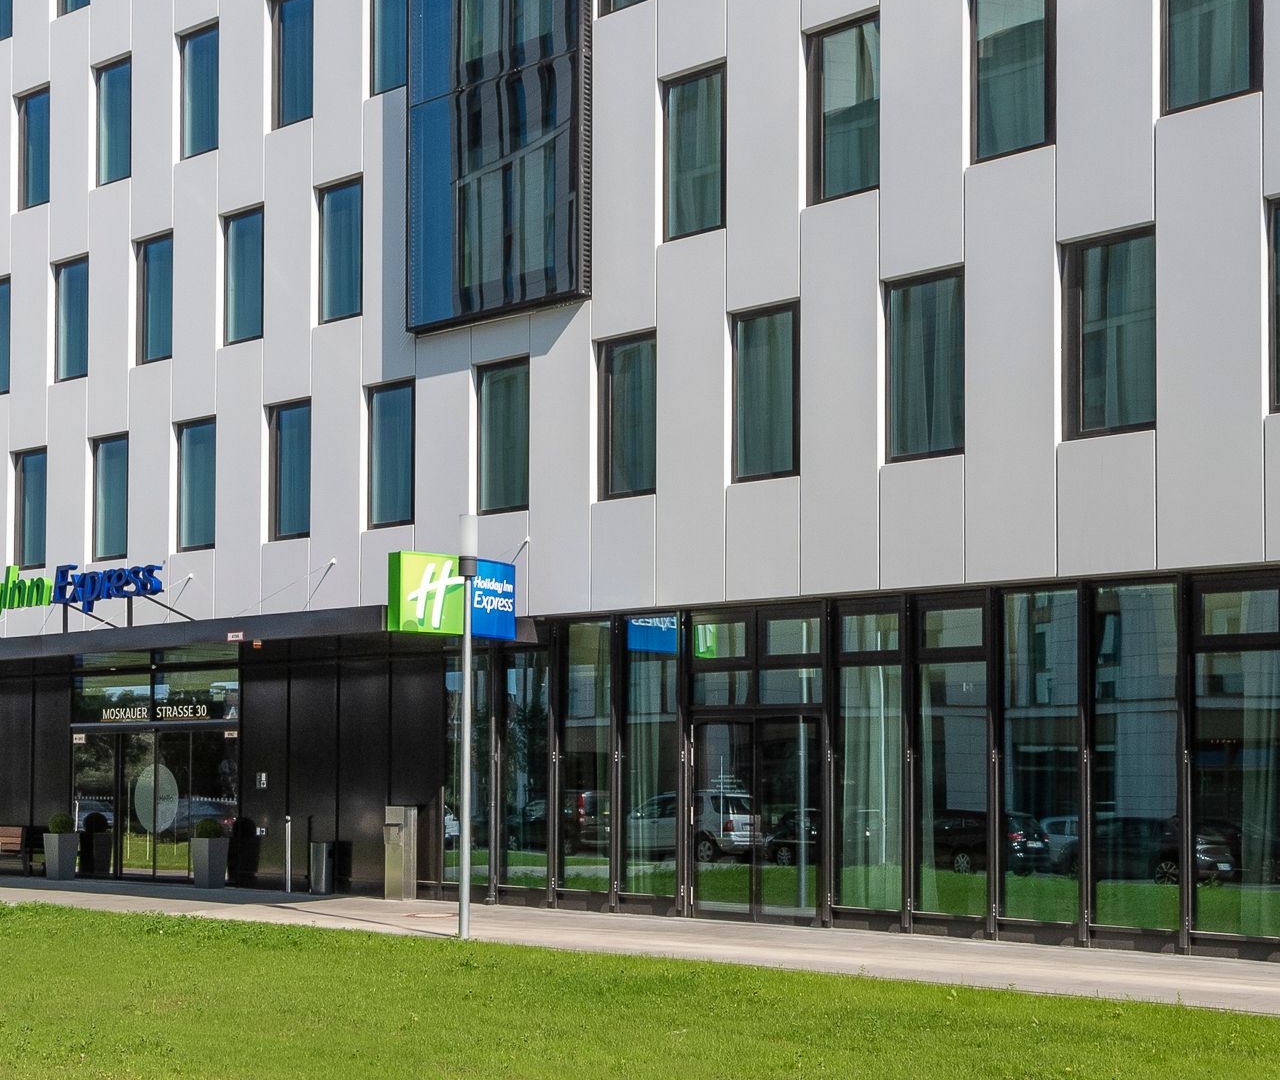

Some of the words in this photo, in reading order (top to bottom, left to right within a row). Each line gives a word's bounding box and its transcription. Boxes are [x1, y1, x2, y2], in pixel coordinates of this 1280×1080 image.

[53, 563, 164, 613] Express
[473, 590, 514, 614] Express
[102, 707, 148, 720] MOSKAUER
[156, 705, 194, 718] STRASSE
[195, 704, 207, 717] 30
